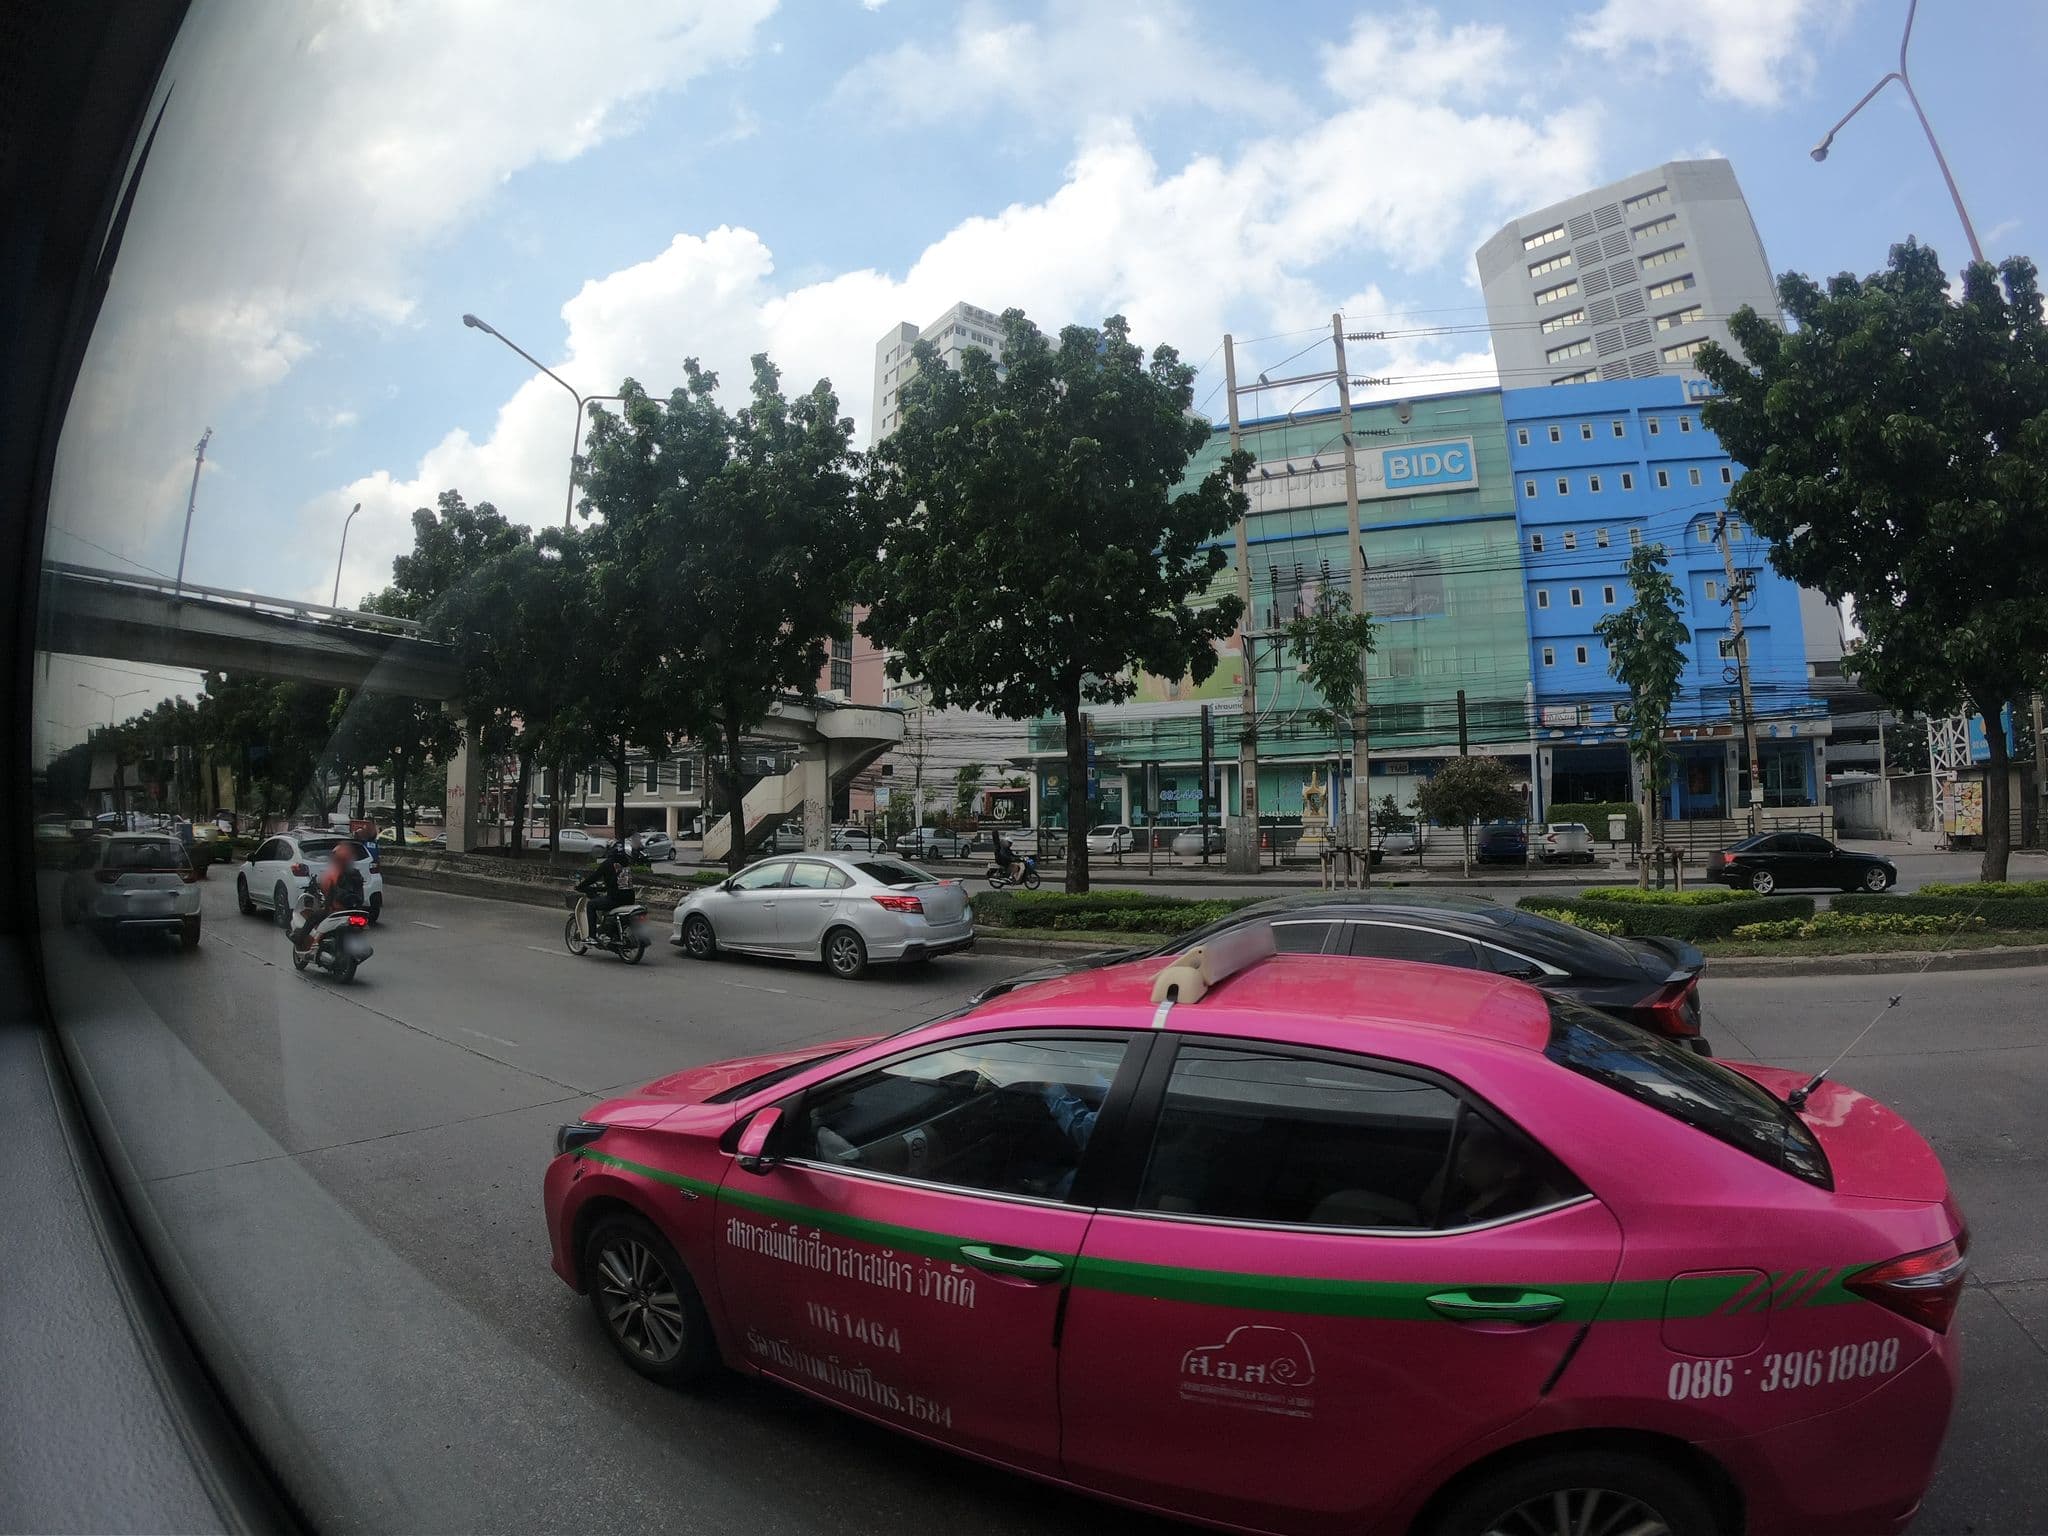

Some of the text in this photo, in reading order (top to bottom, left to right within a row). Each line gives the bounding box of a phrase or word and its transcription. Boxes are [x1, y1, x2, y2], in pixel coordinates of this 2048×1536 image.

[1389, 450, 1466, 480] BIDC
[727, 1217, 976, 1309] สหกรณ์แท็กซี่อาสาสมัคร จำกัด
[843, 1313, 902, 1355] 1464
